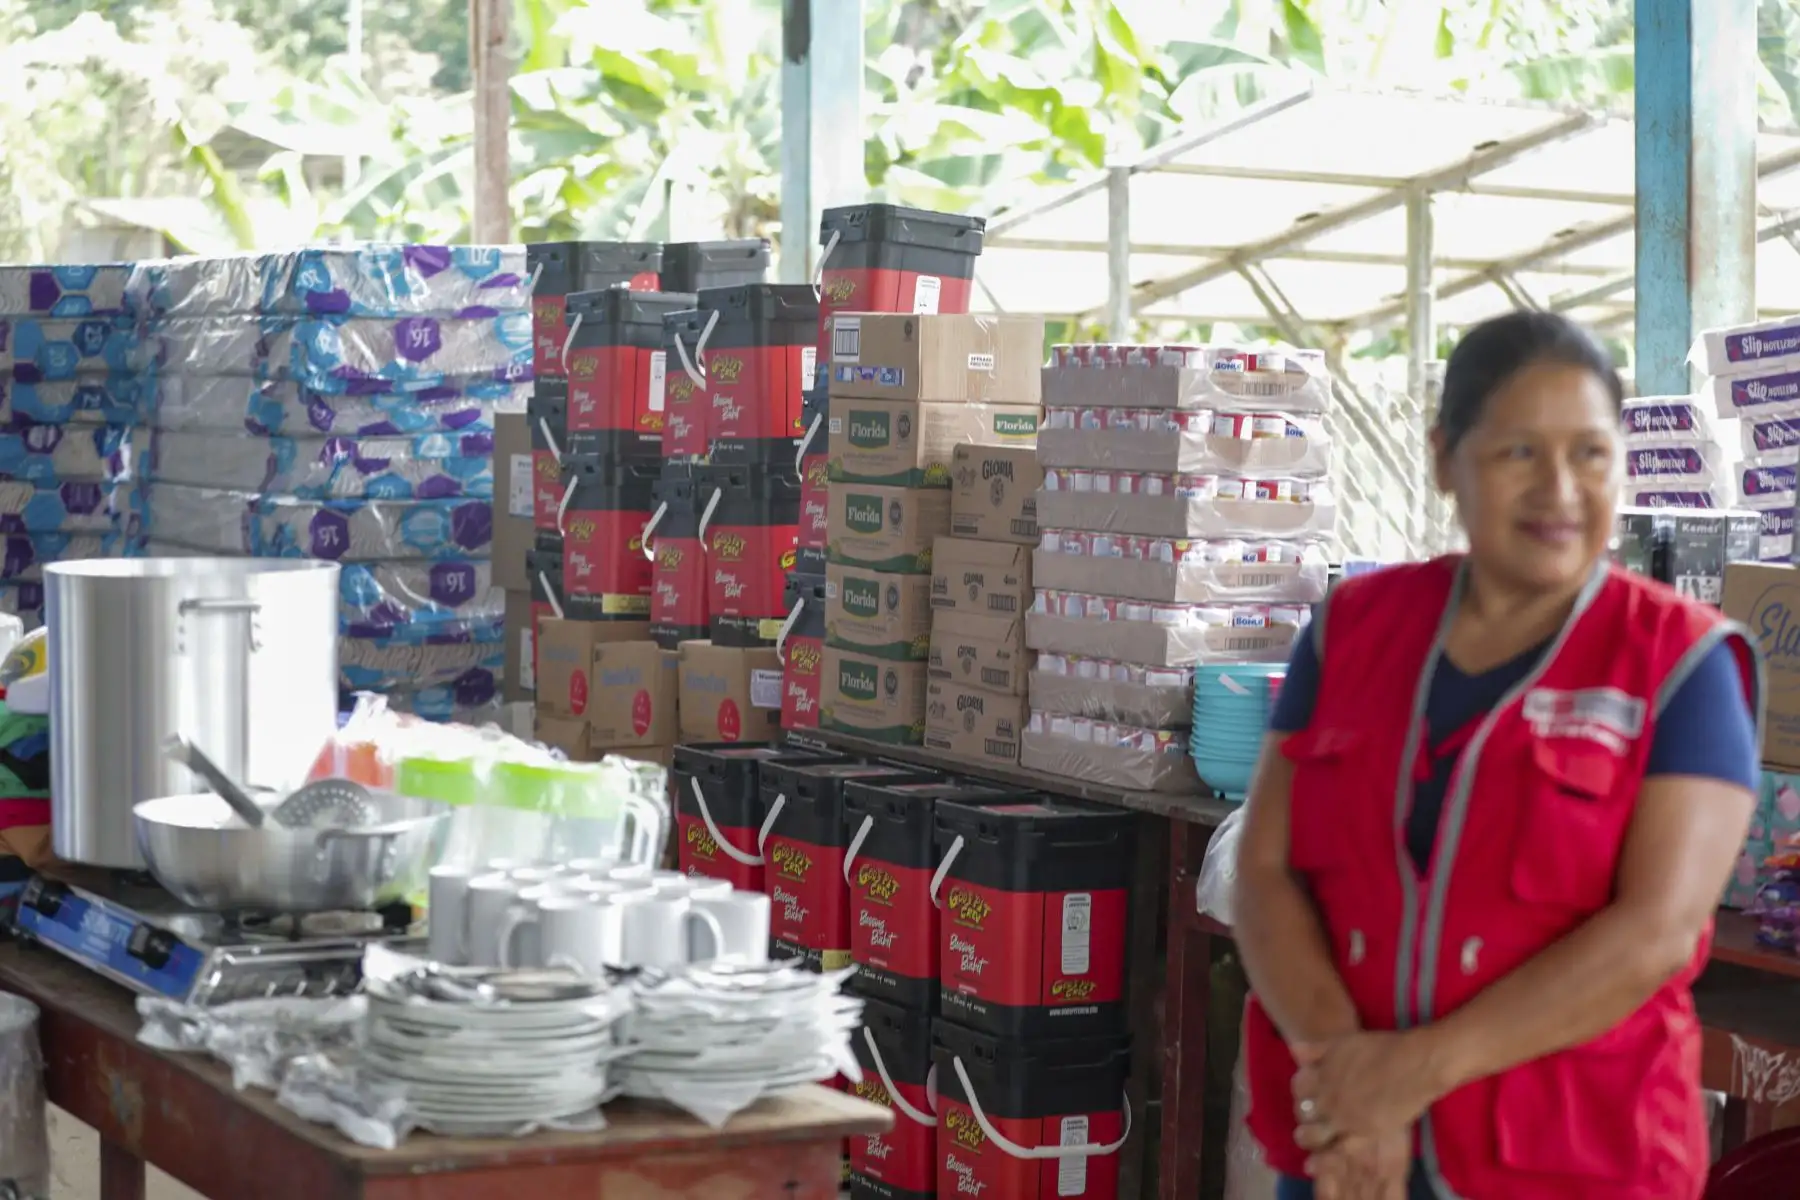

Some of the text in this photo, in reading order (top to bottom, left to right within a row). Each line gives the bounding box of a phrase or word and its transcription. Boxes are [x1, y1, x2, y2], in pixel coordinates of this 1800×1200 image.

[1741, 335, 1762, 357] Slip
[1747, 381, 1767, 401] Slip
[851, 419, 886, 438] Florida
[996, 418, 1034, 431] Florida
[1634, 409, 1651, 430] Slip
[982, 459, 1013, 482] GLORIA
[1639, 451, 1657, 473] Slip
[848, 504, 880, 524] Florida
[1761, 512, 1781, 533] Slip
[845, 588, 876, 609] Florida
[841, 671, 874, 692] Florida
[957, 694, 983, 716] GLORIA
